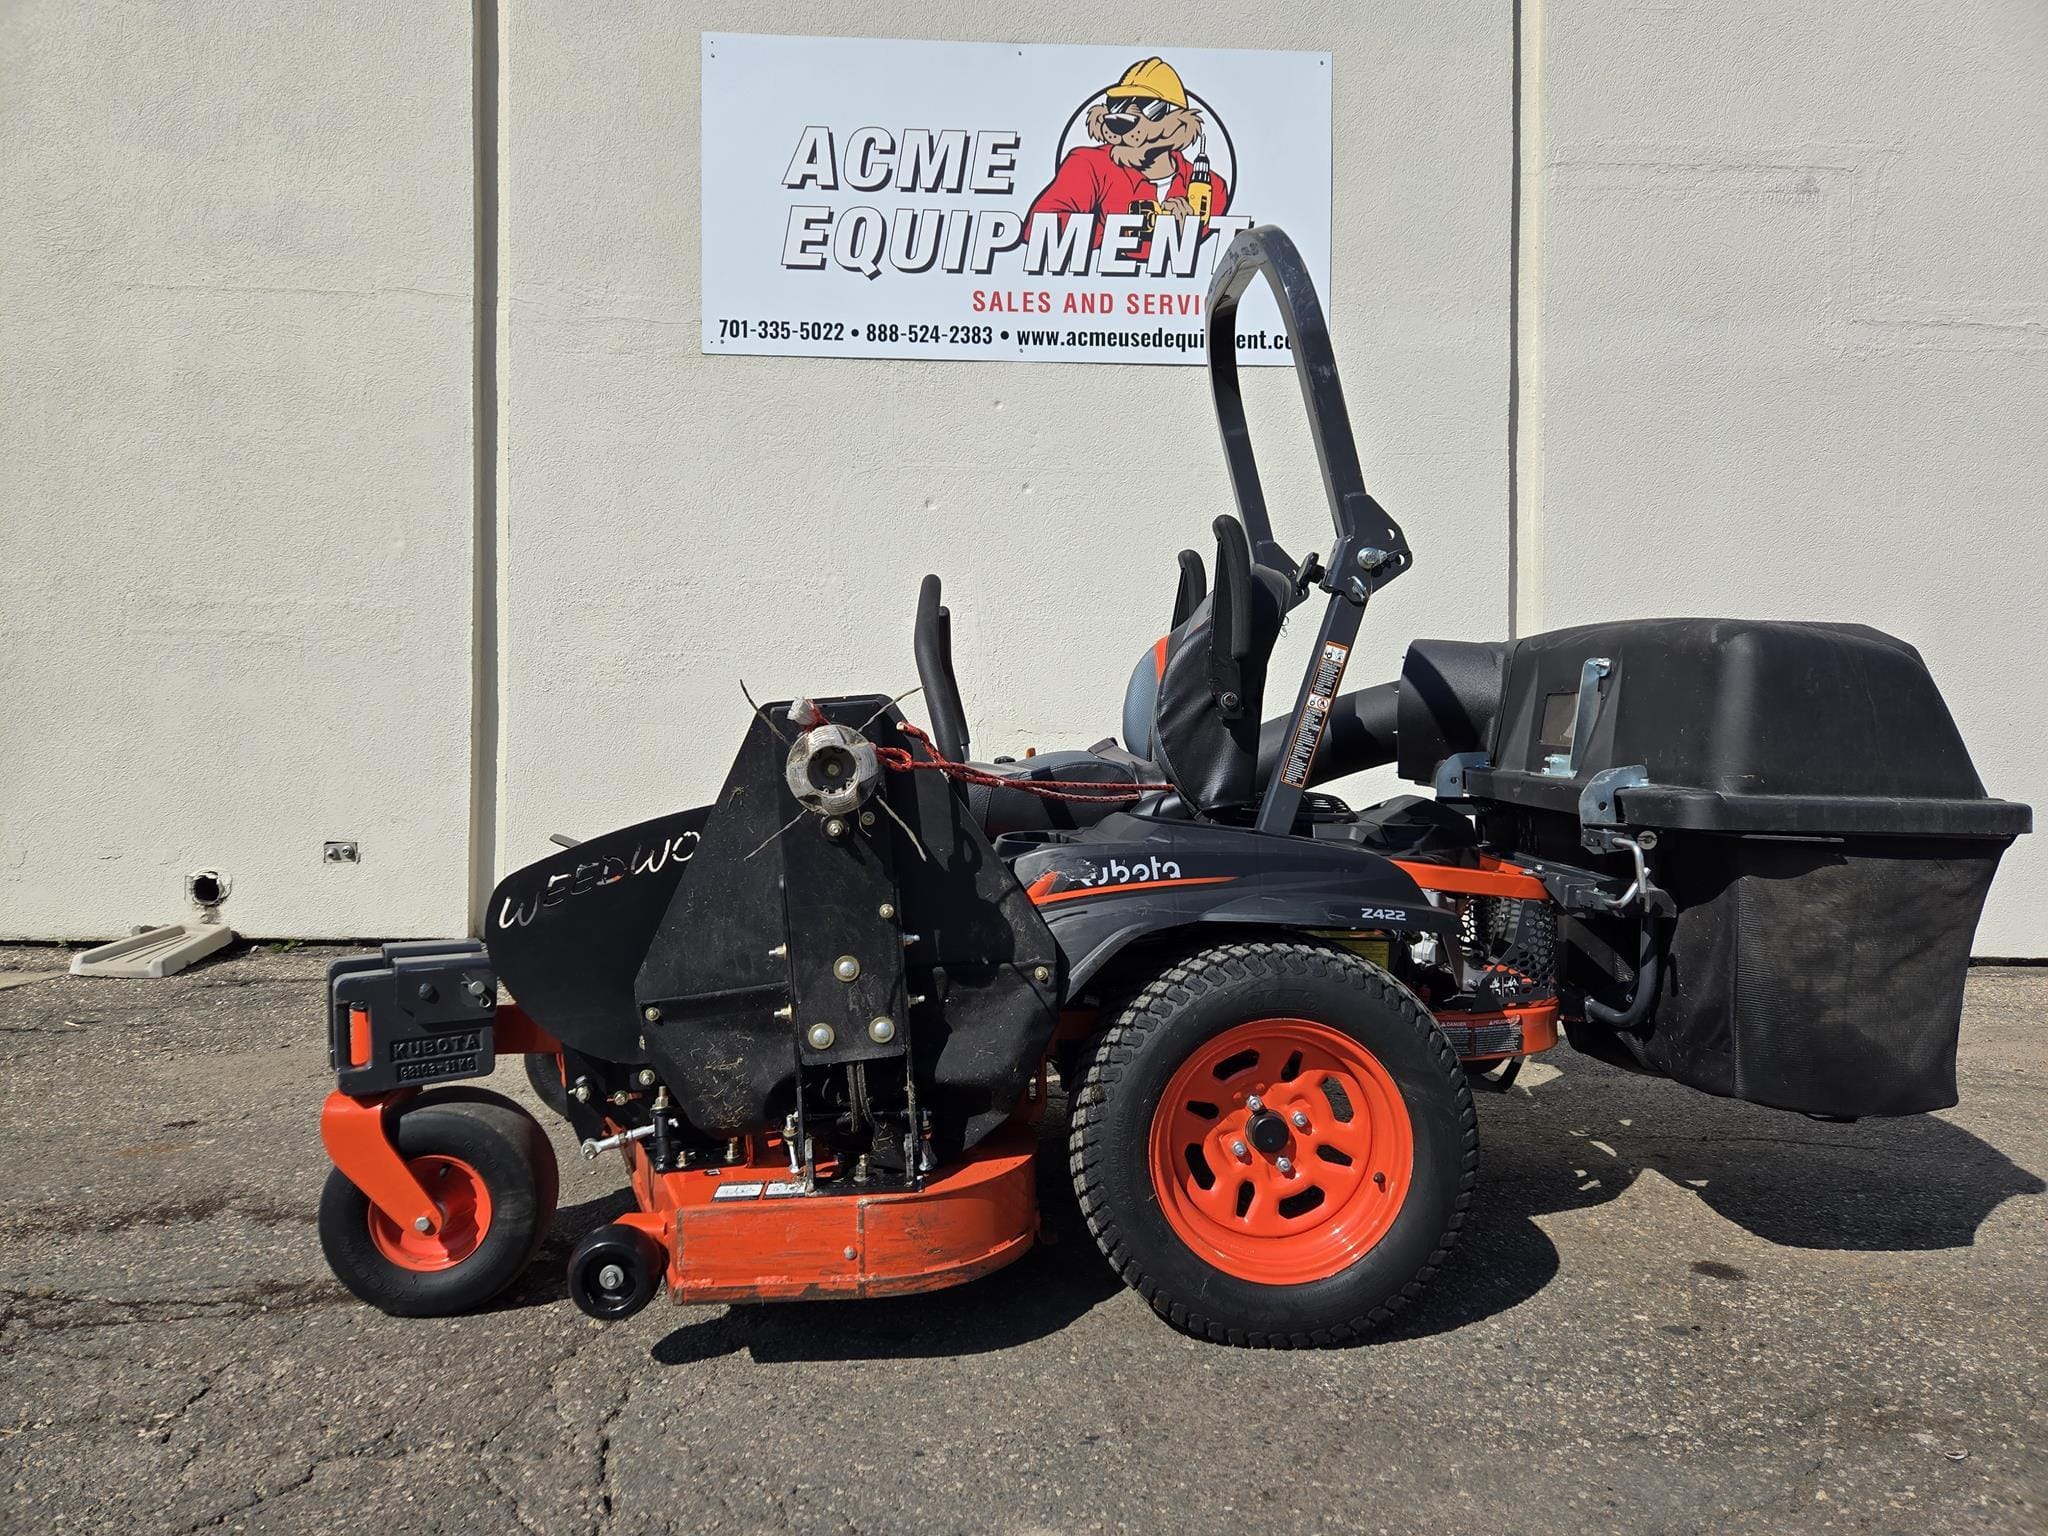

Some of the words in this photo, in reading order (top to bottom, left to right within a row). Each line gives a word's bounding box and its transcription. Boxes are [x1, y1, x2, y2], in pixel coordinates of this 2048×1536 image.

[781, 126, 1021, 194] ACME
[781, 205, 1254, 281] EQUIPMENT
[972, 290, 1051, 314] SALES
[1063, 292, 1114, 315] AND
[1126, 292, 1208, 316] SERVI
[719, 319, 845, 341] 701-335-5022
[866, 323, 994, 344] 888-524-2383
[1017, 327, 1292, 353] www.acmeusedequient.c
[1361, 907, 1407, 921] Z422
[393, 1034, 478, 1059] KUBOTA
